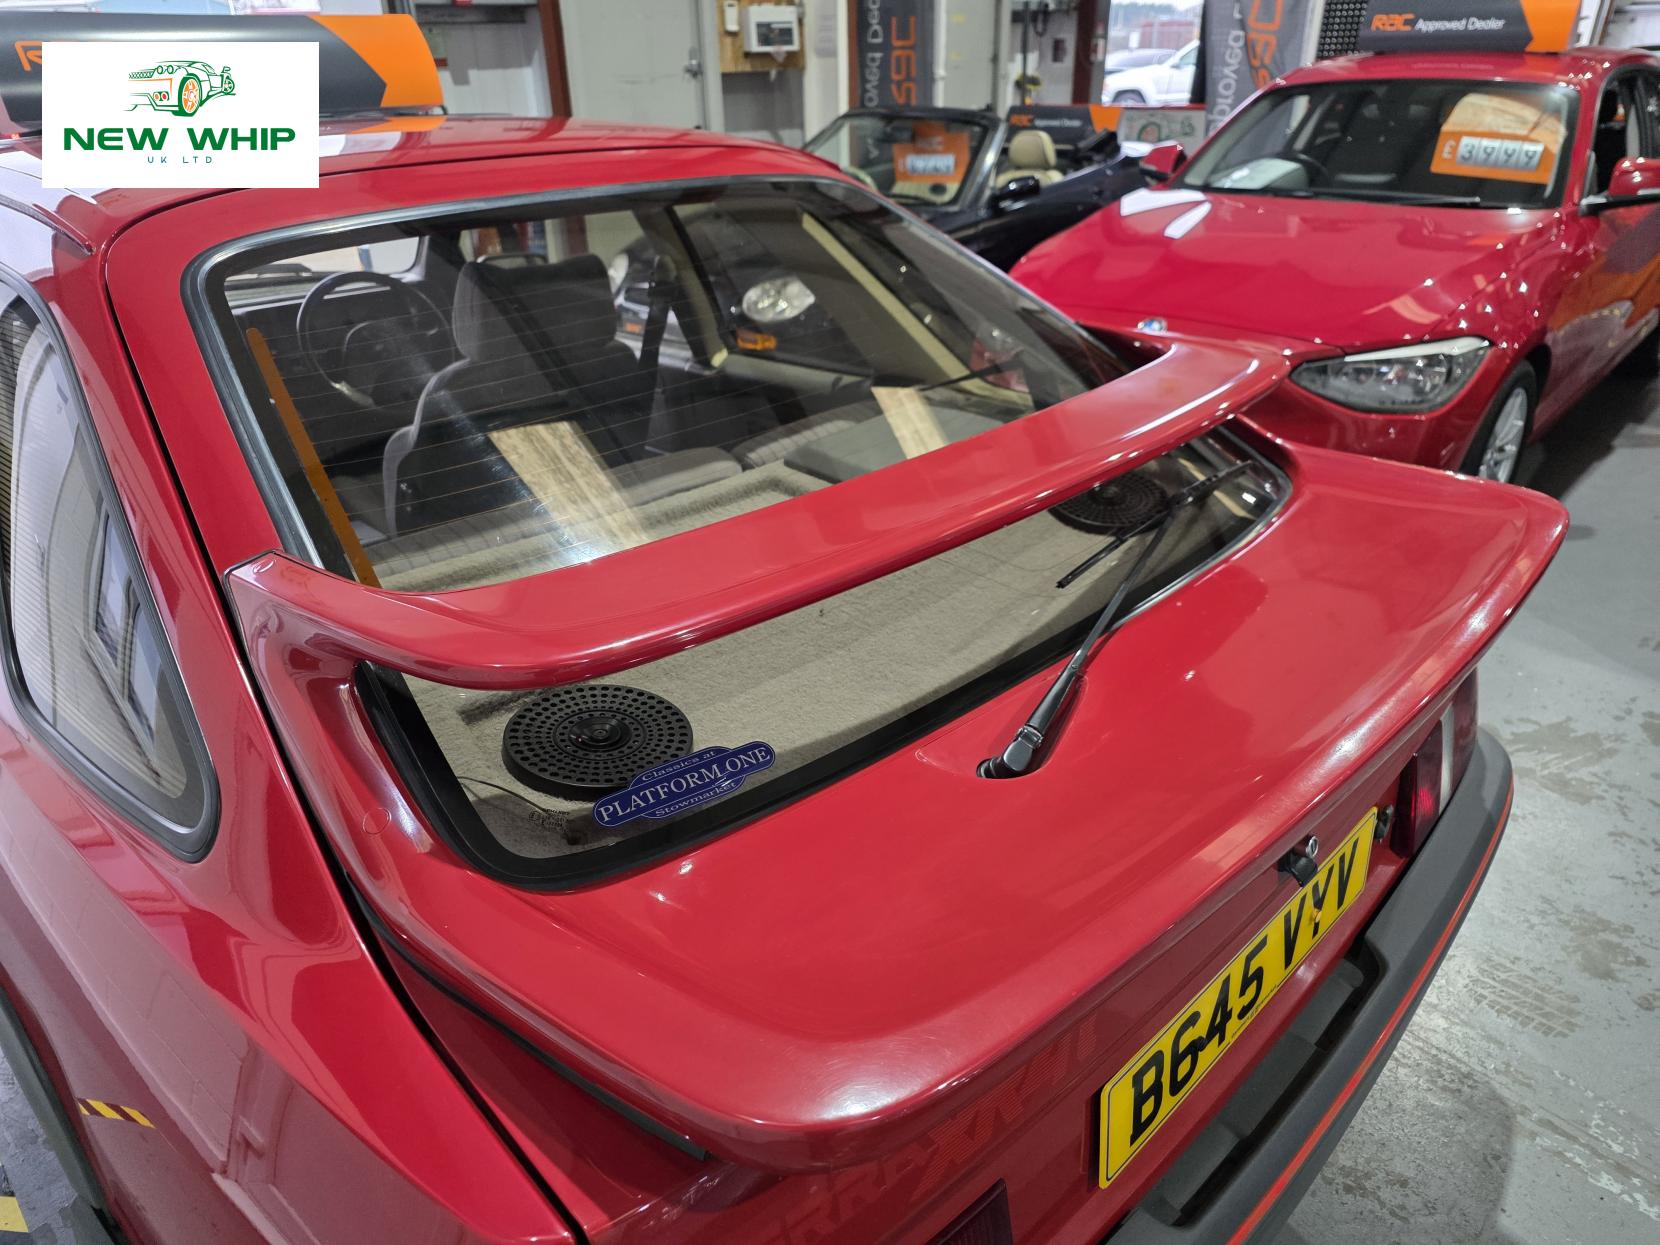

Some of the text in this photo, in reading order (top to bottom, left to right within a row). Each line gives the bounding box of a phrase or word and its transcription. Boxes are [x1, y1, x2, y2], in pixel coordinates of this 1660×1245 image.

[1370, 13, 1506, 33] RAC Approved Dealer
[641, 750, 717, 782] Classics at
[598, 763, 724, 823] PLATFORM
[725, 747, 772, 776] ONE
[654, 781, 738, 818] Stowmarket
[1129, 936, 1269, 1147] B645
[1283, 837, 1359, 971] VYV
